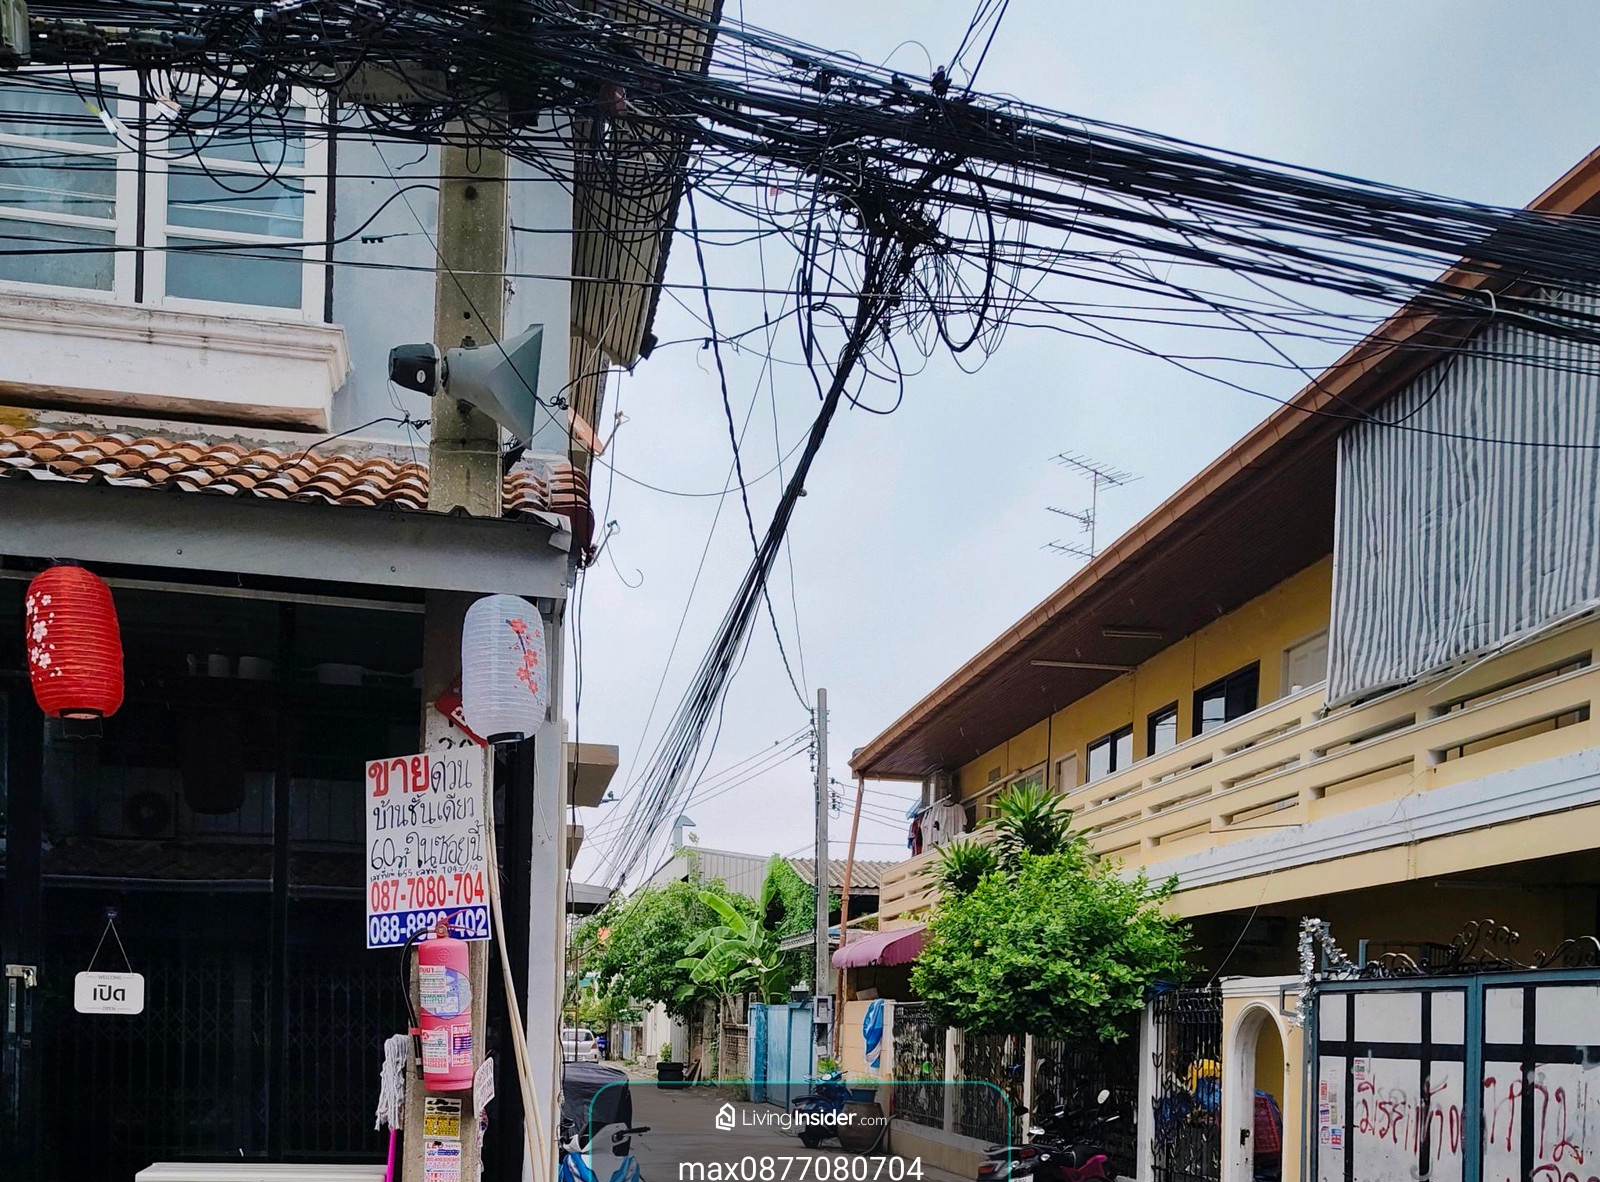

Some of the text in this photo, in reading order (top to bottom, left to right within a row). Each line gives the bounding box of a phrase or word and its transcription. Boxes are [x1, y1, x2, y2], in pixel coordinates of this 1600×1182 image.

[373, 793, 474, 831] บ้านชั้นเดียว
[371, 872, 484, 912] 087-7080-704
[93, 984, 126, 1001] เปิด
